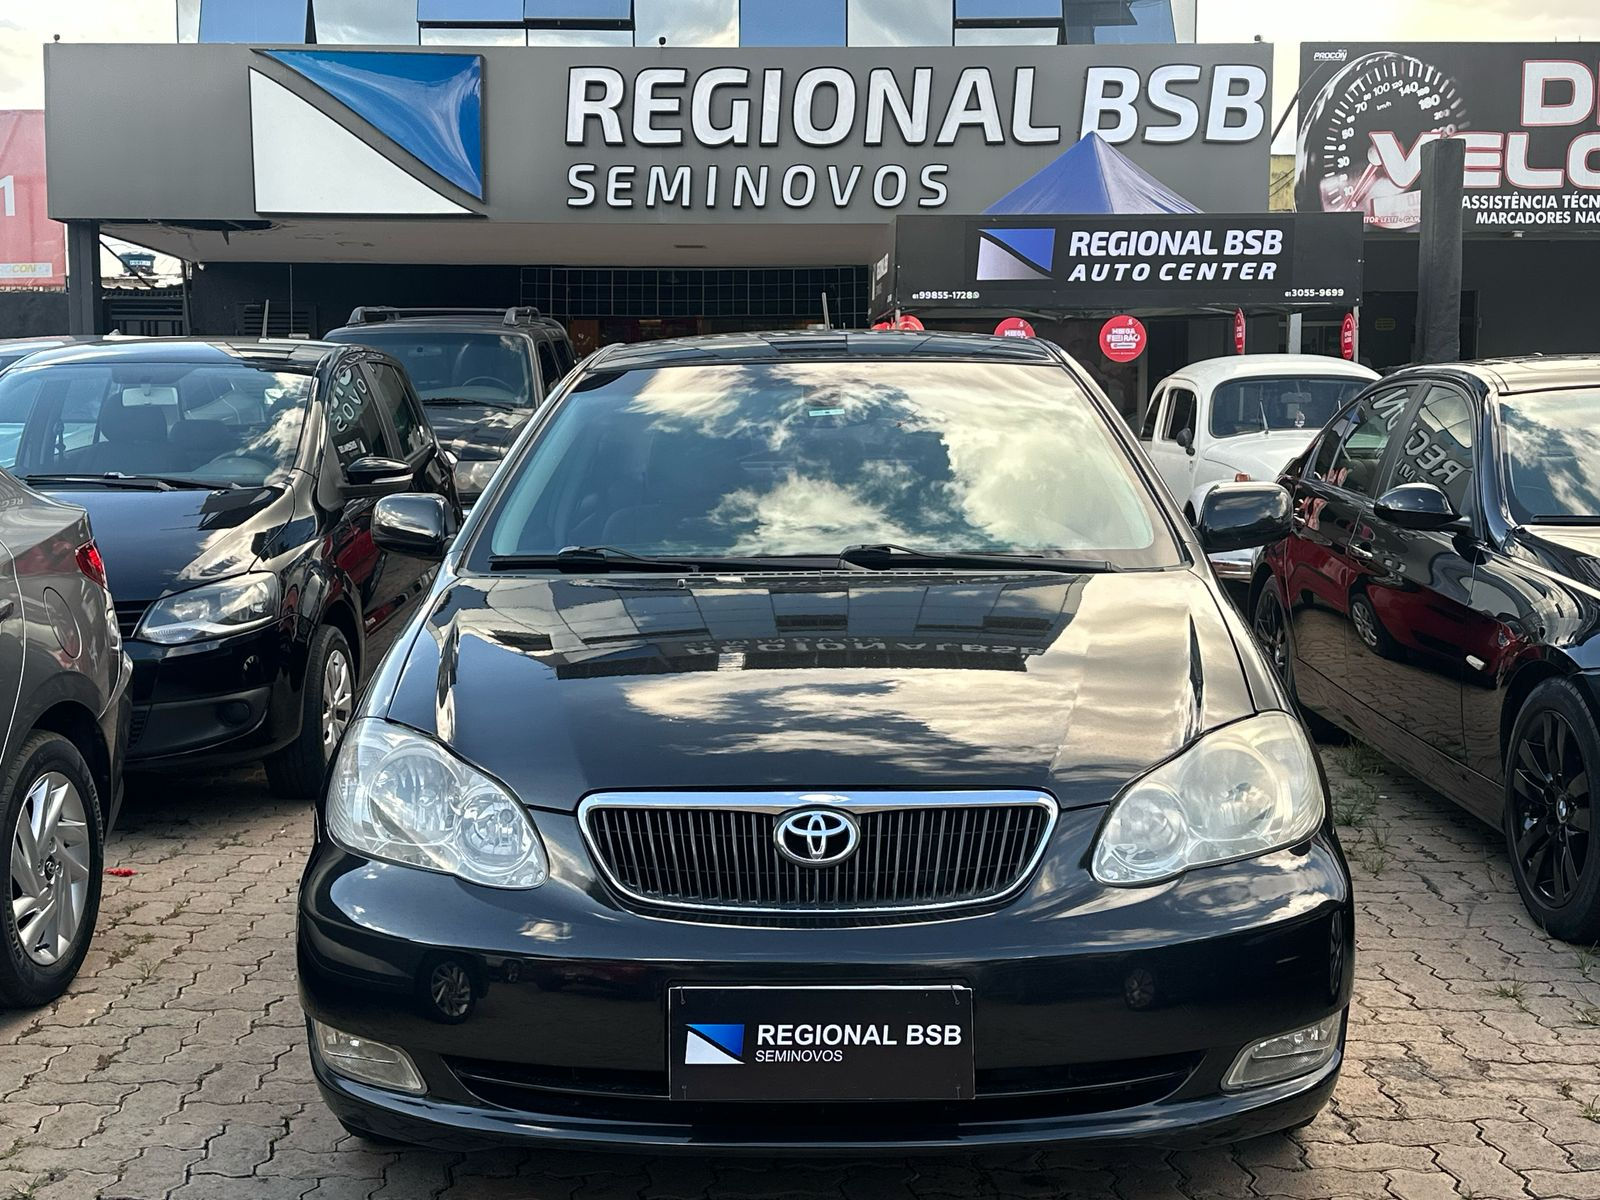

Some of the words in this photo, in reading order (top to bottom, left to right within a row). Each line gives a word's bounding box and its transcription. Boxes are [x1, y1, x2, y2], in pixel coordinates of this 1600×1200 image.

[1373, 82, 1391, 97] 100
[1521, 59, 1600, 127] D
[565, 66, 1061, 148] REGIONAL
[1080, 63, 1267, 147] BSB
[1355, 101, 1368, 114] 70
[566, 163, 950, 208] SEMINOVOS
[1462, 191, 1558, 209] ASSISTÊNCIA
[1475, 212, 1571, 225] MARCADORES
[1069, 231, 1218, 257] REGIONAL
[1223, 230, 1283, 255] BSB
[1067, 263, 1151, 282] AUTO
[1159, 262, 1277, 280] CENTER
[756, 1023, 898, 1047] REGIONAL
[905, 1023, 963, 1047] BSB
[754, 1049, 844, 1063] SEMINOVOS
